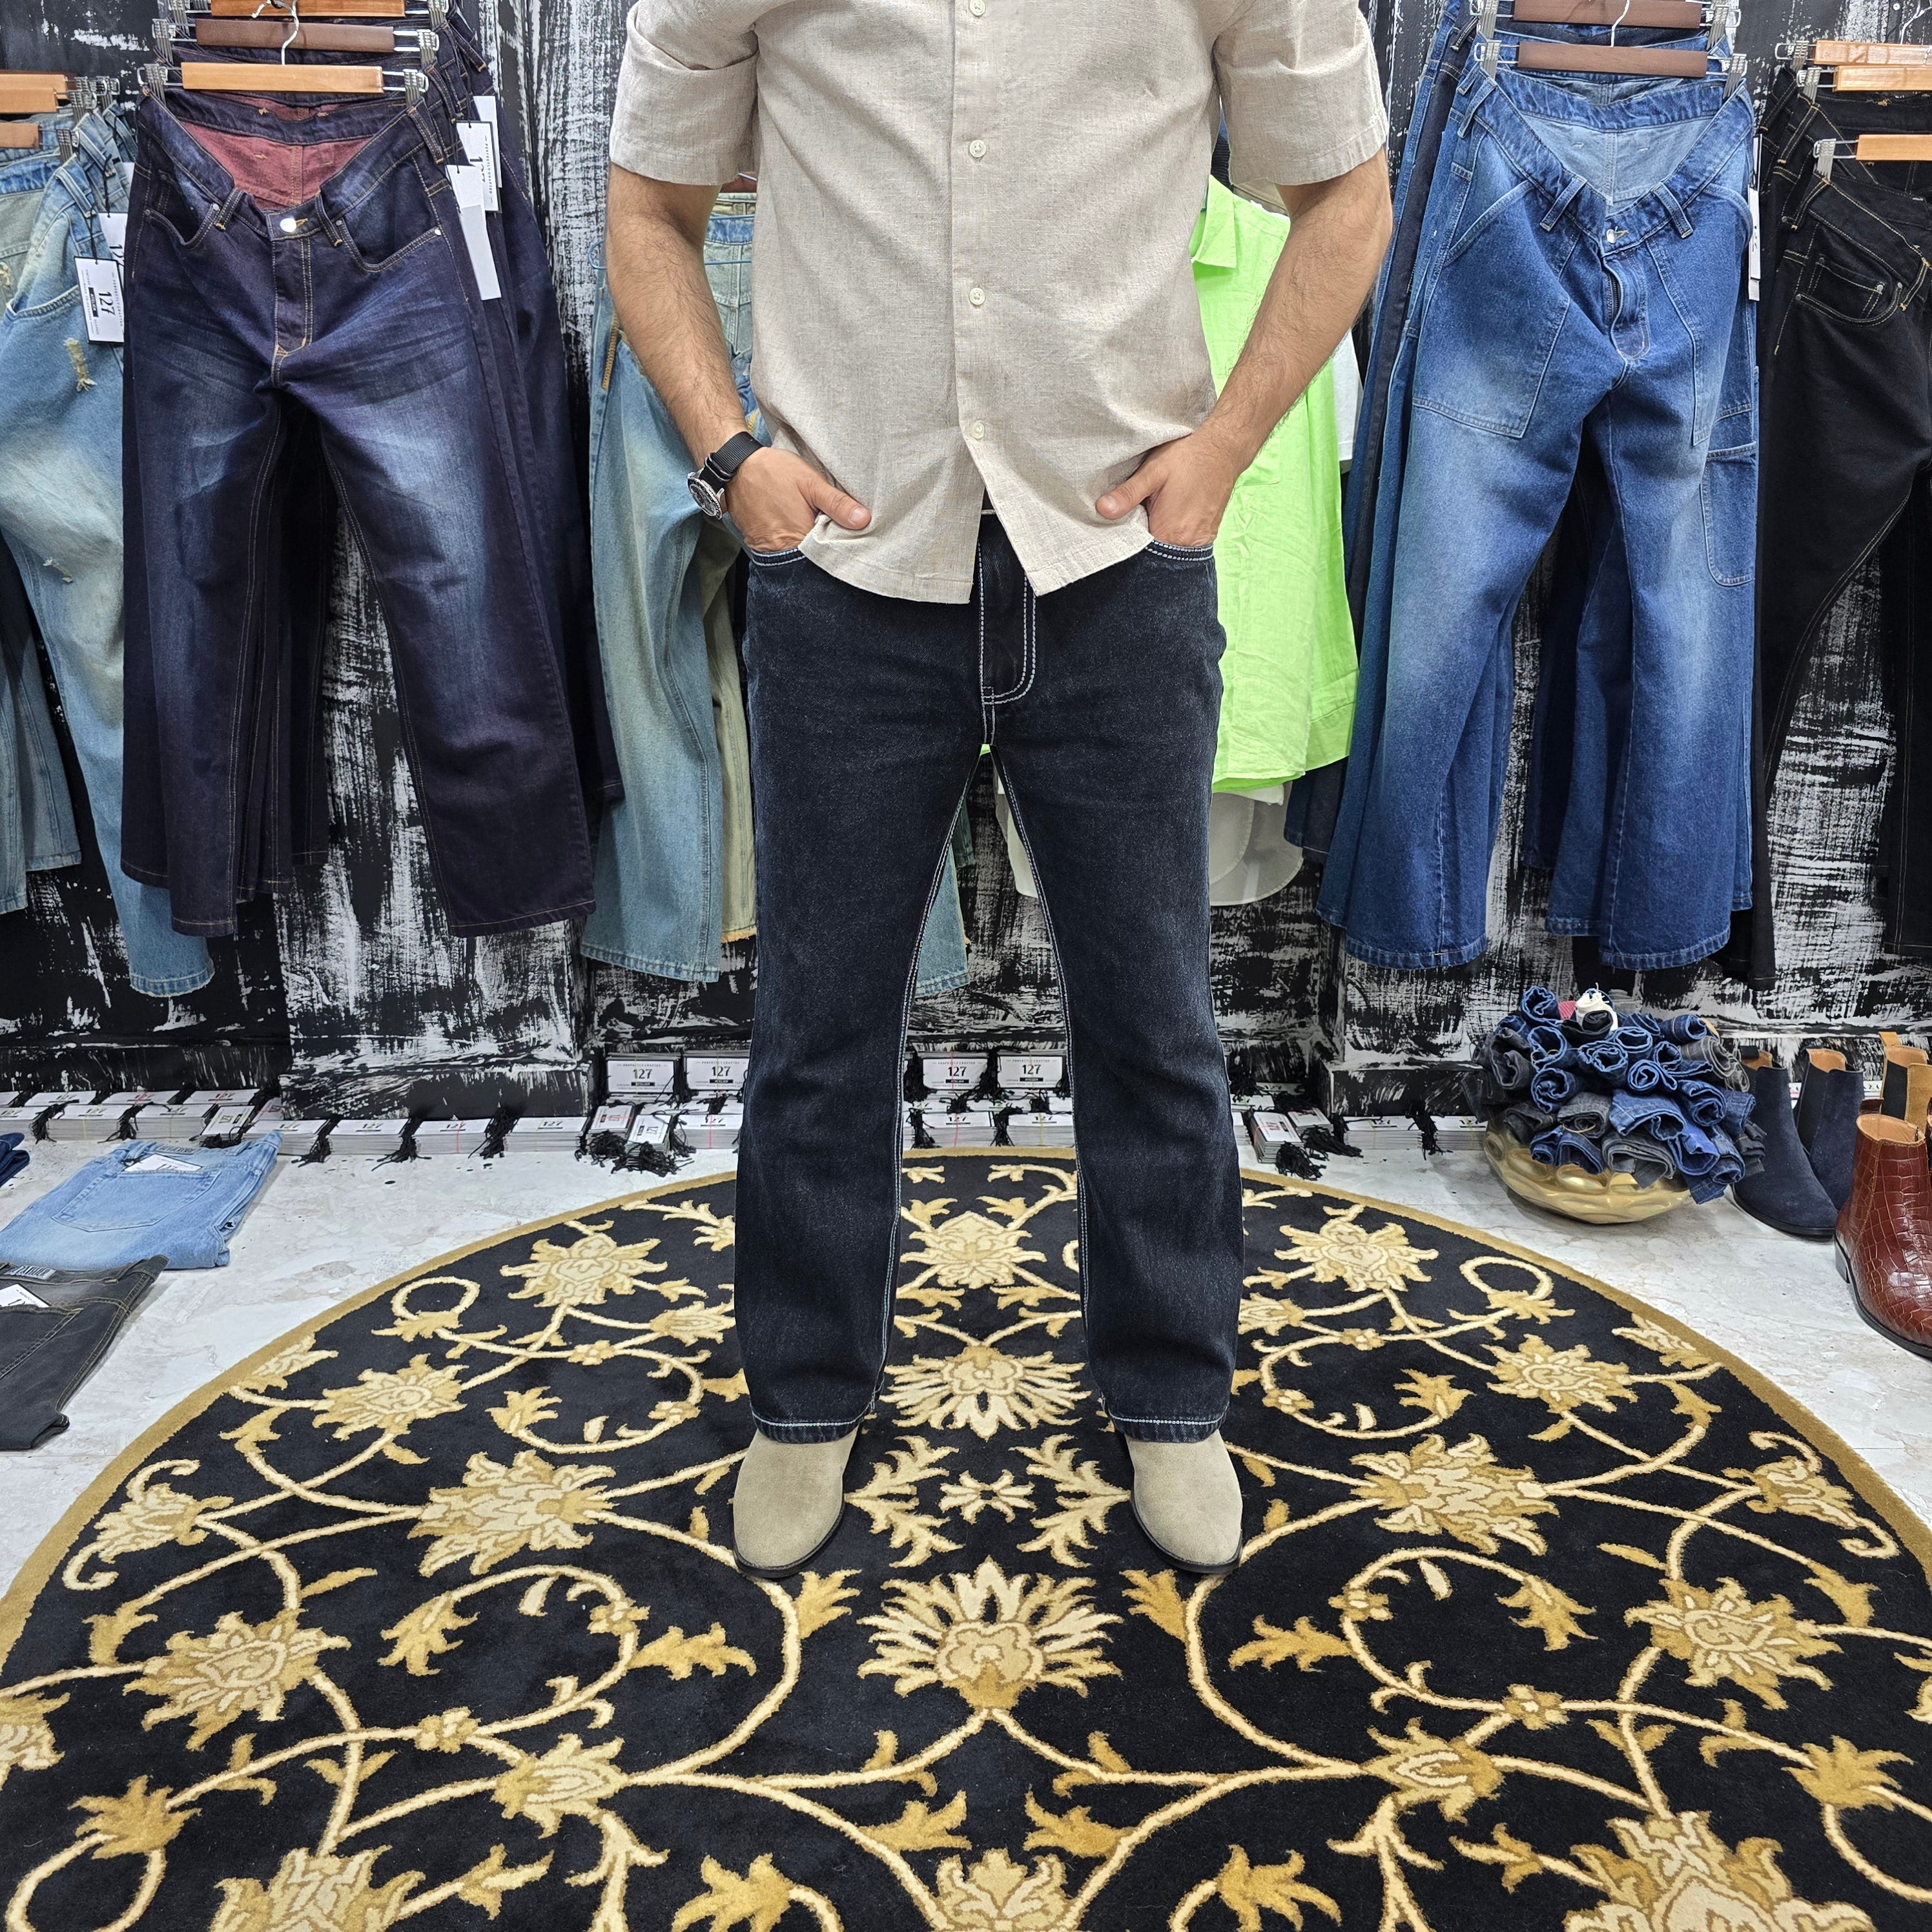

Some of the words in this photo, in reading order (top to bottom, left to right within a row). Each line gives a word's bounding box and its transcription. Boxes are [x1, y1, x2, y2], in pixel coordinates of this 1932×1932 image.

[98, 291, 116, 316] 127
[633, 1069, 652, 1079] 127
[712, 1066, 731, 1076] 127
[948, 1066, 967, 1076] 127
[1022, 1064, 1042, 1074] 127
